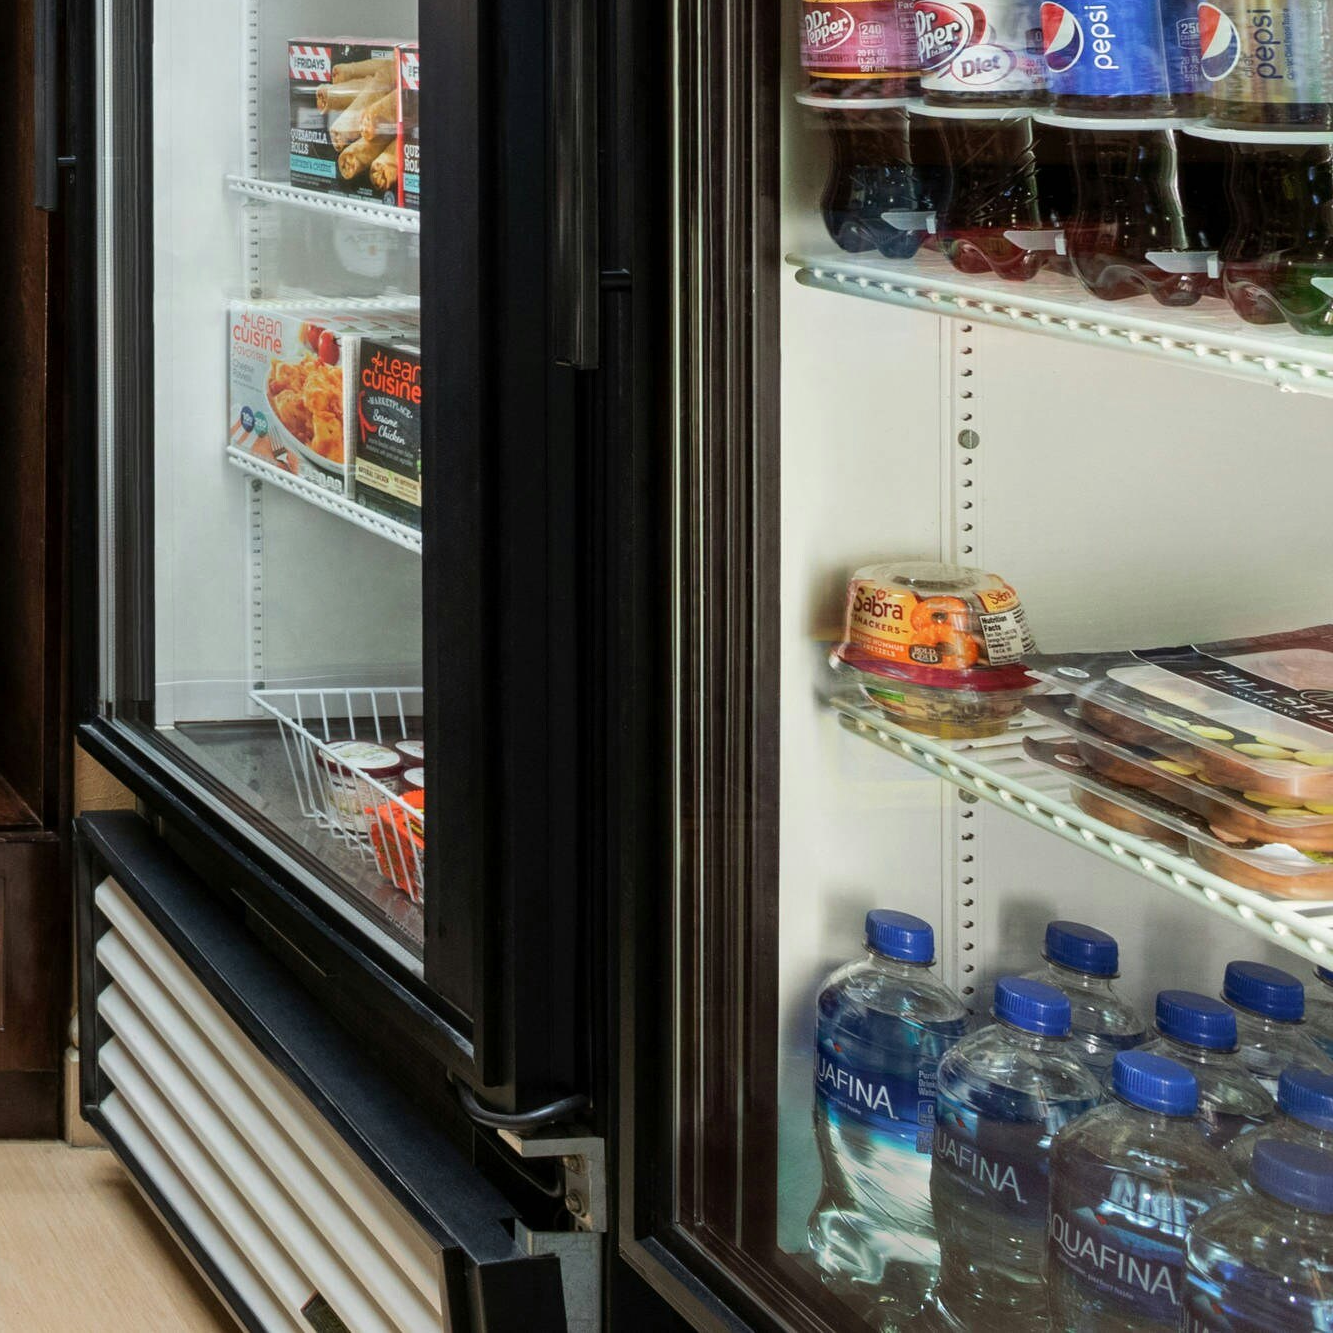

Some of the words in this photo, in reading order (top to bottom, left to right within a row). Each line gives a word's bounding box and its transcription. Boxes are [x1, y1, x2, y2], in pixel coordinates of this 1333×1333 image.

[861, 23, 882, 36] 240
[1083, 4, 1120, 70] pepsi
[857, 49, 867, 57] 20
[1247, 8, 1284, 80] pepsi
[297, 59, 325, 70] FRIDAYS
[860, 65, 873, 73] 591
[961, 54, 1002, 78] Diet
[250, 312, 282, 338] Lean
[233, 324, 282, 356] cuisine
[362, 368, 421, 404] cuisine
[373, 409, 398, 428] Sesame
[378, 425, 406, 445] Chicken
[854, 586, 904, 621] Sabra
[984, 624, 1001, 633] Facts
